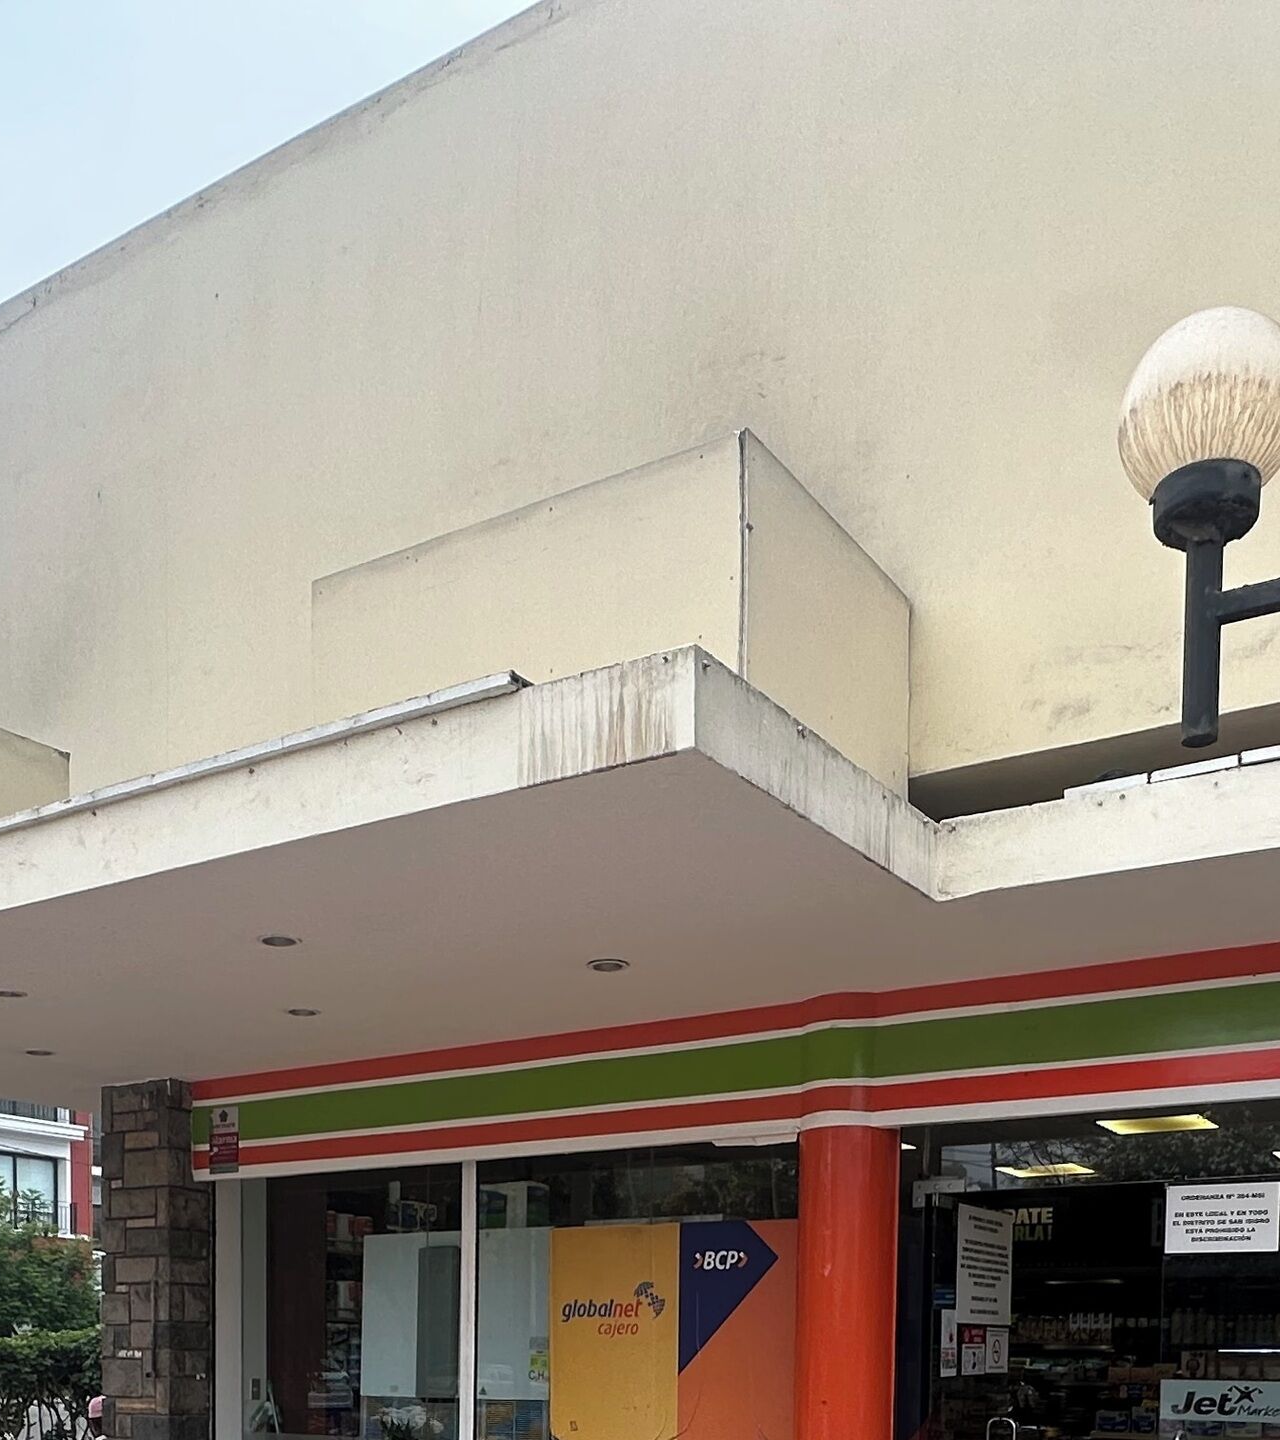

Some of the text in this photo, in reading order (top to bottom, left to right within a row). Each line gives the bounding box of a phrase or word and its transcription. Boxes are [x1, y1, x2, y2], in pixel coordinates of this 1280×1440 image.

[703, 1250, 738, 1270] BCP
[562, 1295, 642, 1322] globalnet
[598, 1321, 639, 1339] cajero
[1171, 1391, 1238, 1416] Jet
